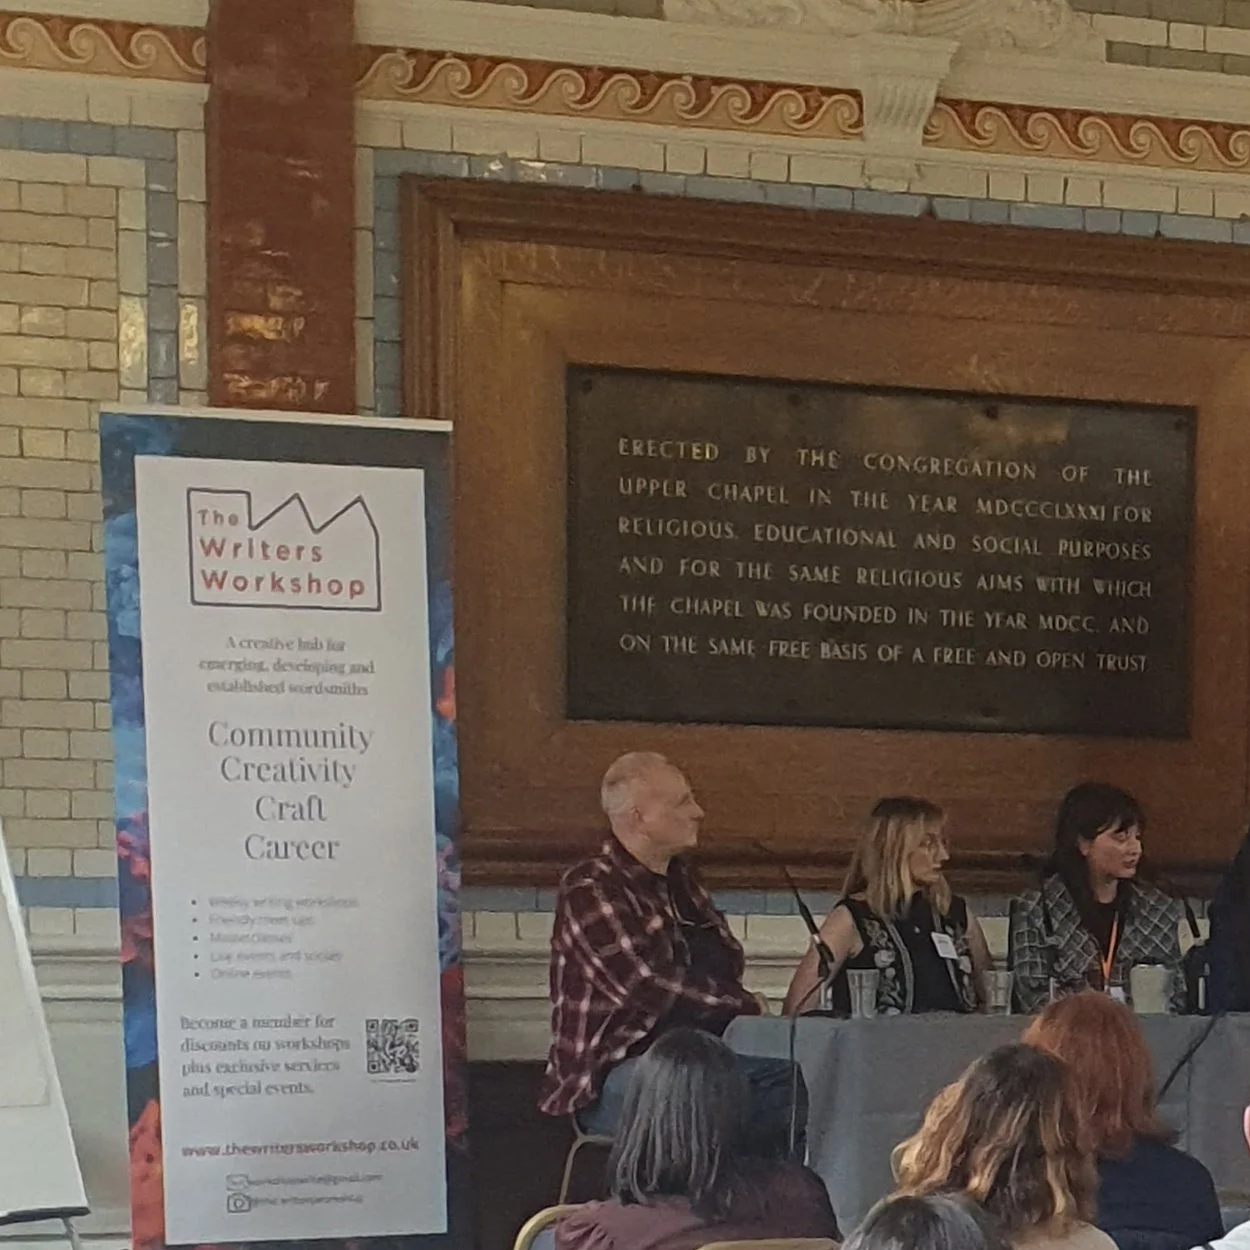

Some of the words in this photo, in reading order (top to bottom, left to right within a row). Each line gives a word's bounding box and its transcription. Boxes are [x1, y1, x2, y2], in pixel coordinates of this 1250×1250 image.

[618, 438, 718, 460] ERECTED
[746, 446, 771, 464] BY
[798, 449, 840, 469] THE
[863, 453, 1036, 479] CONGREGATION
[1061, 465, 1089, 482] OF
[1114, 467, 1152, 486] THE
[619, 477, 687, 497] UPPER
[708, 483, 788, 504] CHAPEL
[809, 488, 832, 505] IN
[851, 490, 888, 510] THE
[907, 494, 957, 513] YEAR
[1113, 505, 1152, 523] FOR
[198, 509, 240, 526] The
[200, 536, 323, 562] Writers
[753, 524, 897, 548] EDUCATIONAL
[913, 533, 956, 550] AND
[972, 535, 1042, 555] SOCIAL
[1059, 539, 1151, 560] PURPOSES
[201, 569, 365, 599] Workshop
[619, 556, 663, 575] AND
[680, 559, 720, 578] FOR
[736, 562, 772, 580] THE
[789, 564, 840, 584] SAME
[857, 567, 963, 589] RELIGIOUS
[976, 574, 1023, 593] AIMS
[1036, 576, 1080, 595] WITH
[1093, 578, 1151, 598] WHICH
[620, 595, 655, 616] THE
[670, 597, 744, 617] CHAPEL
[755, 600, 792, 619] WAS
[803, 603, 897, 624] FOUNDED
[908, 607, 928, 625] IN
[940, 609, 974, 627] THE
[984, 611, 1027, 629] YEAR
[1109, 616, 1148, 634] AND
[226, 636, 236, 649] A
[239, 637, 294, 650] creative
[298, 637, 323, 651] hub
[326, 638, 346, 652] for
[619, 634, 650, 651] ON
[661, 635, 697, 654] THE
[709, 637, 755, 656] SAME
[769, 640, 810, 658] FREE
[820, 642, 867, 661] BASIS
[878, 644, 903, 662] OF
[912, 647, 925, 663] A
[934, 647, 975, 665] FREE
[986, 650, 1026, 667] AND
[1036, 651, 1085, 669] OPEN
[273, 657, 346, 676] developing
[349, 660, 375, 674] and
[207, 679, 285, 694] established
[288, 681, 369, 696] wordsmiths
[208, 720, 375, 755] Community
[221, 756, 357, 789] Creativity
[255, 794, 327, 822] Craft
[245, 833, 340, 861] Career
[180, 1015, 236, 1030] Become
[239, 1018, 248, 1029] a
[252, 1014, 311, 1029] member
[315, 1013, 336, 1028] for
[180, 1037, 249, 1053] discounts
[275, 1036, 350, 1052] workshops
[182, 1060, 212, 1077] plus
[215, 1059, 281, 1073] exclusive
[284, 1059, 341, 1072] services
[183, 1082, 210, 1098] and
[213, 1081, 262, 1099] special
